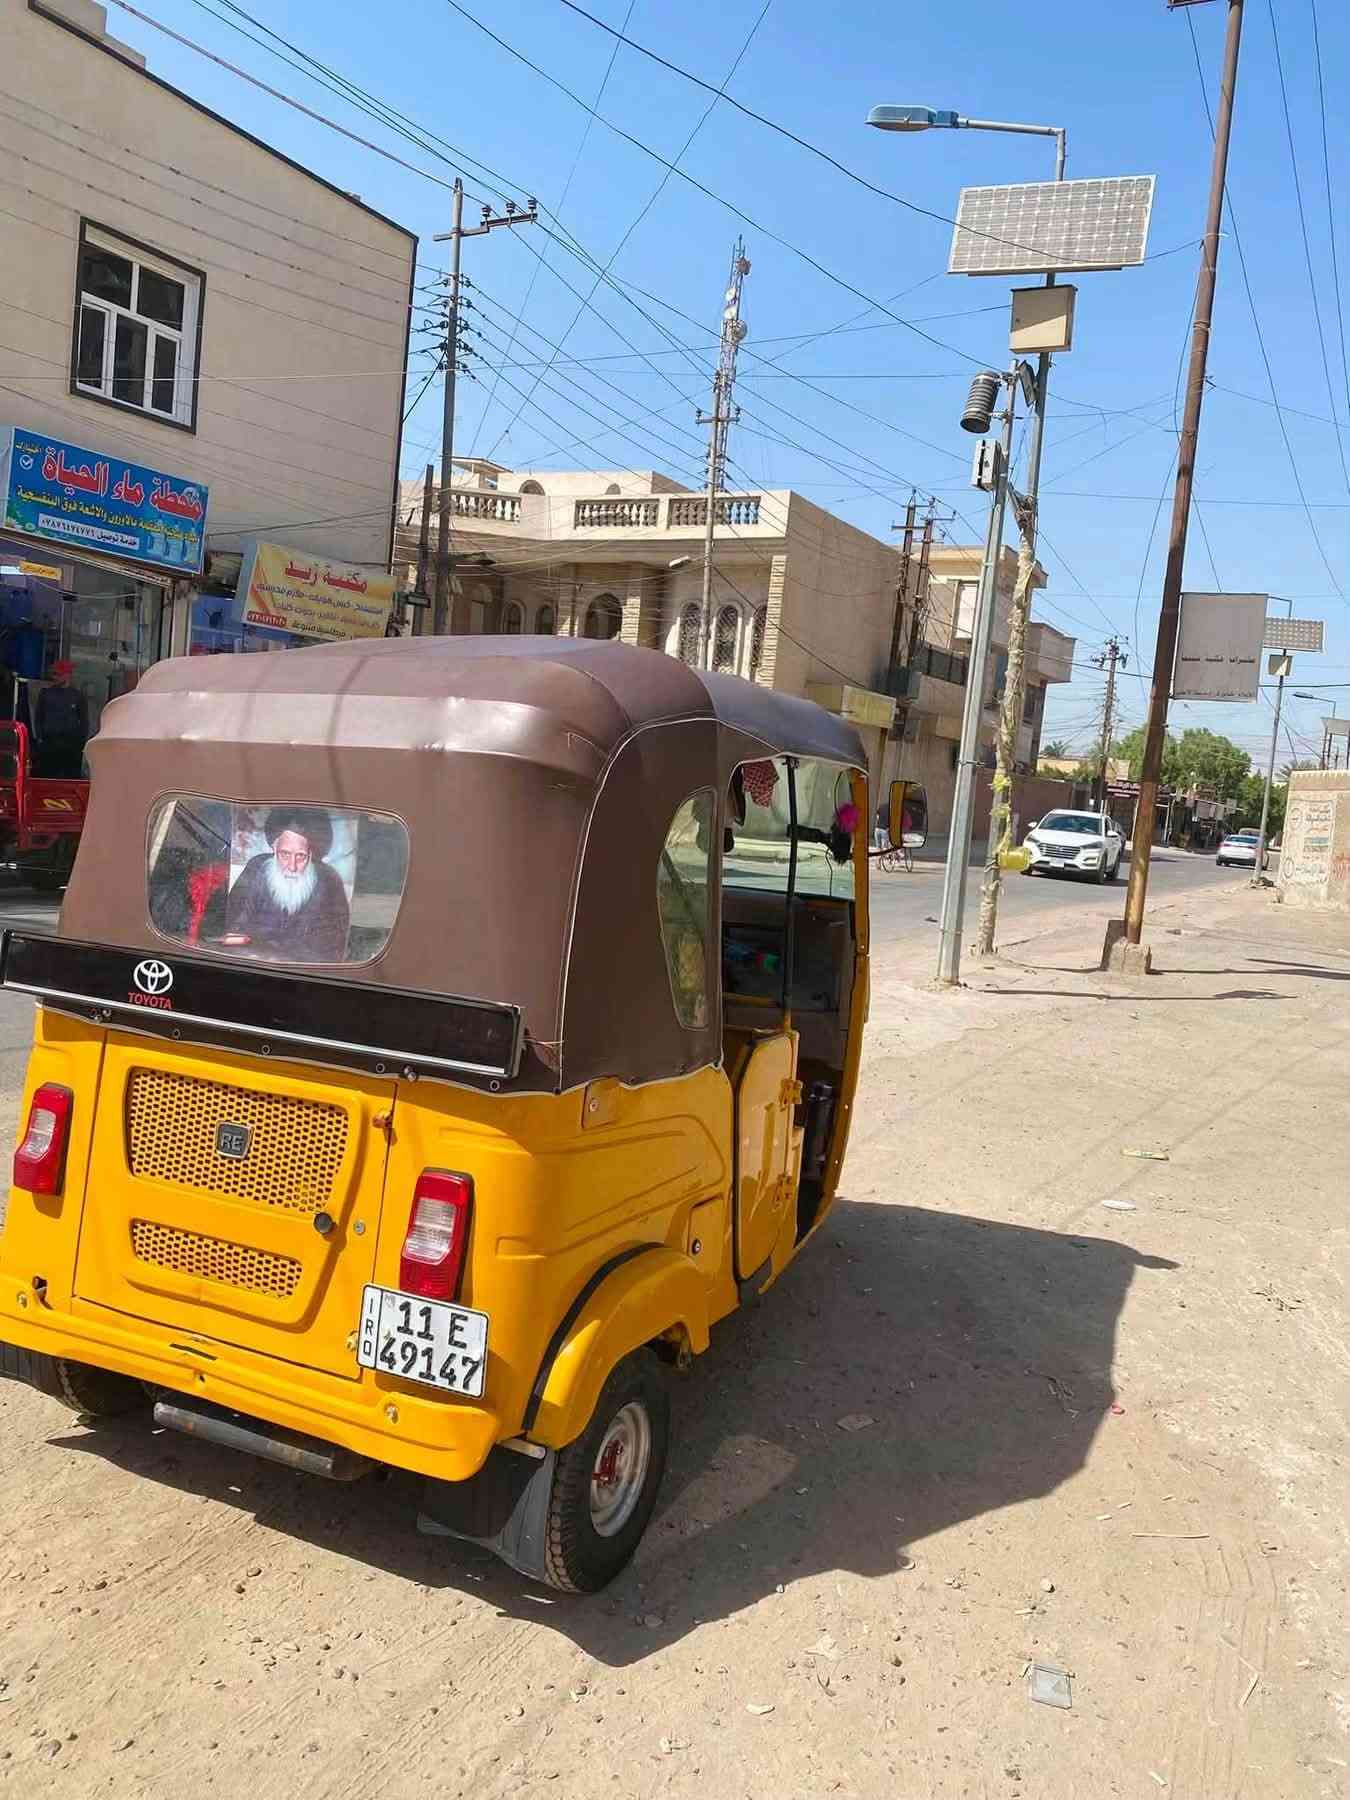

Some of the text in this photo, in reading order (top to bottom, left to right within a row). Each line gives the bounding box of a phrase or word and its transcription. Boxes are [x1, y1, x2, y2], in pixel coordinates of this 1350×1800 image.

[42, 446, 204, 521] محطة ماء الحياة
[322, 563, 367, 593] مكتبة
[128, 992, 173, 1009] TOYOTA
[221, 1133, 243, 1152] RE
[397, 1301, 435, 1341] 11
[448, 1312, 469, 1349] E
[379, 1336, 482, 1391] 49147
